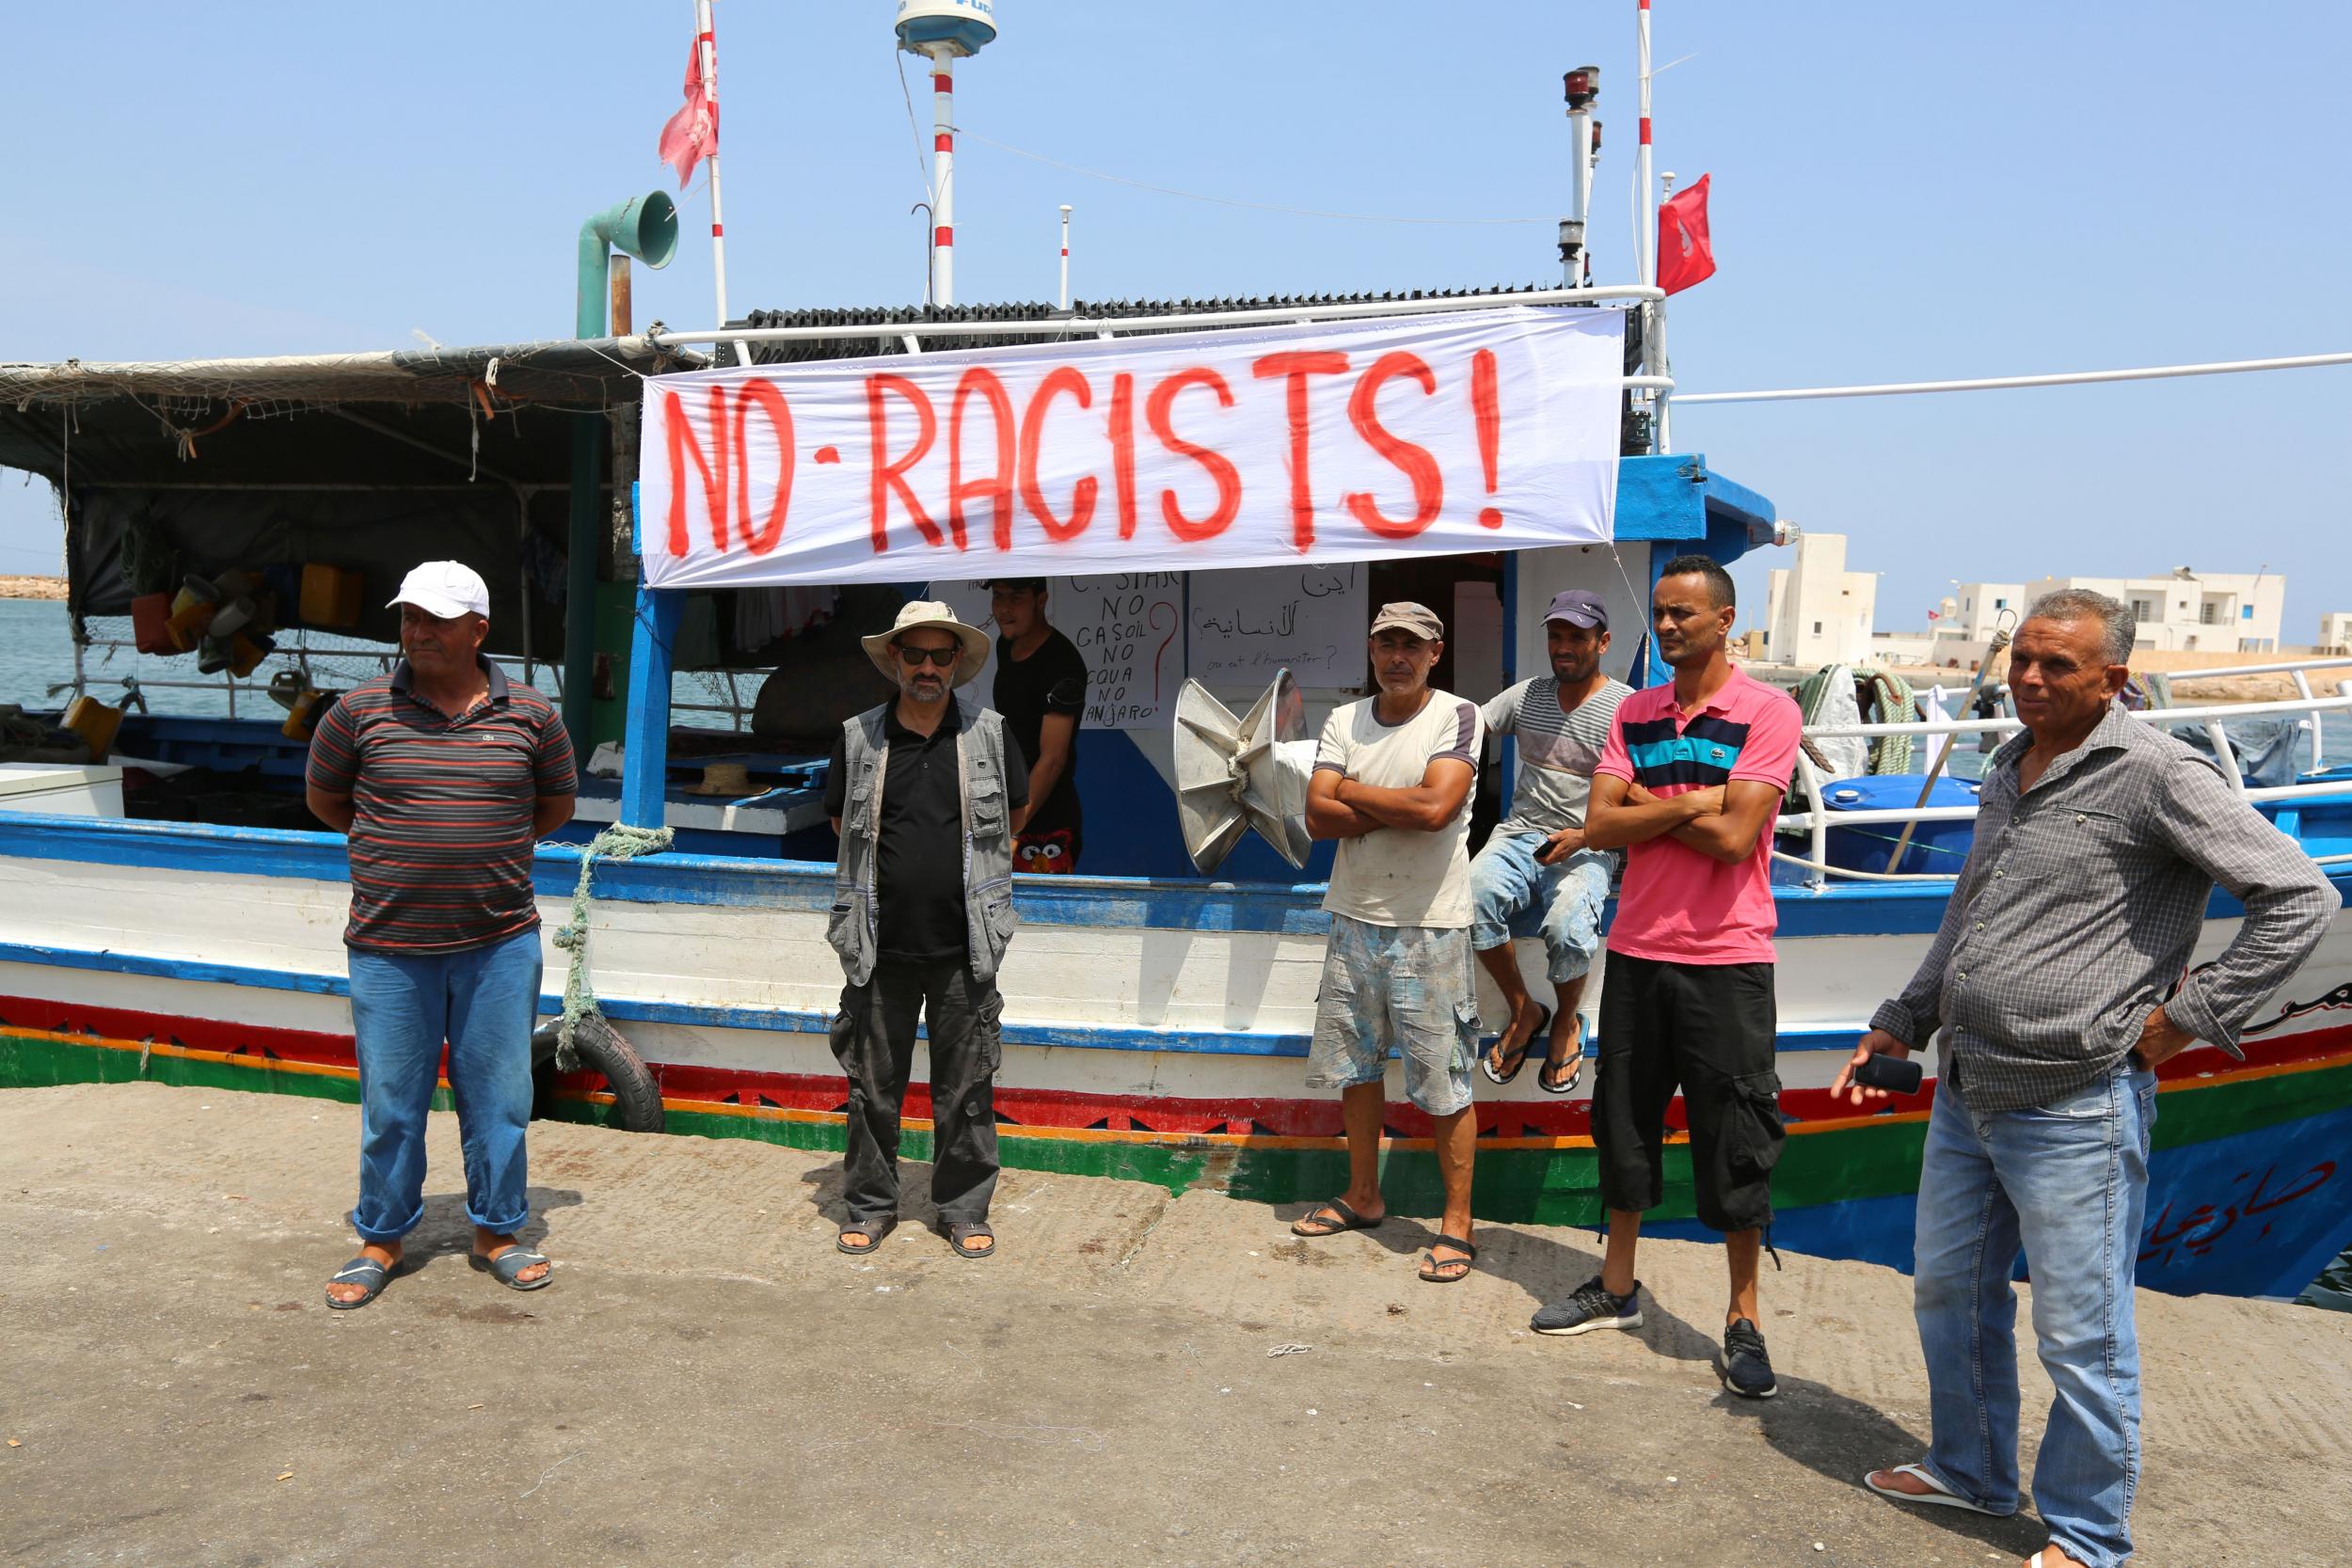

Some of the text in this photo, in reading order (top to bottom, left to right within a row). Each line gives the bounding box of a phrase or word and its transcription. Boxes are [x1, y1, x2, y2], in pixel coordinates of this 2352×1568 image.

[664, 377, 795, 558] NO
[866, 349, 1503, 555] RACISTS!
[1102, 594, 1144, 621] NO
[1103, 644, 1134, 664] NO
[1098, 687, 1126, 702] NO
